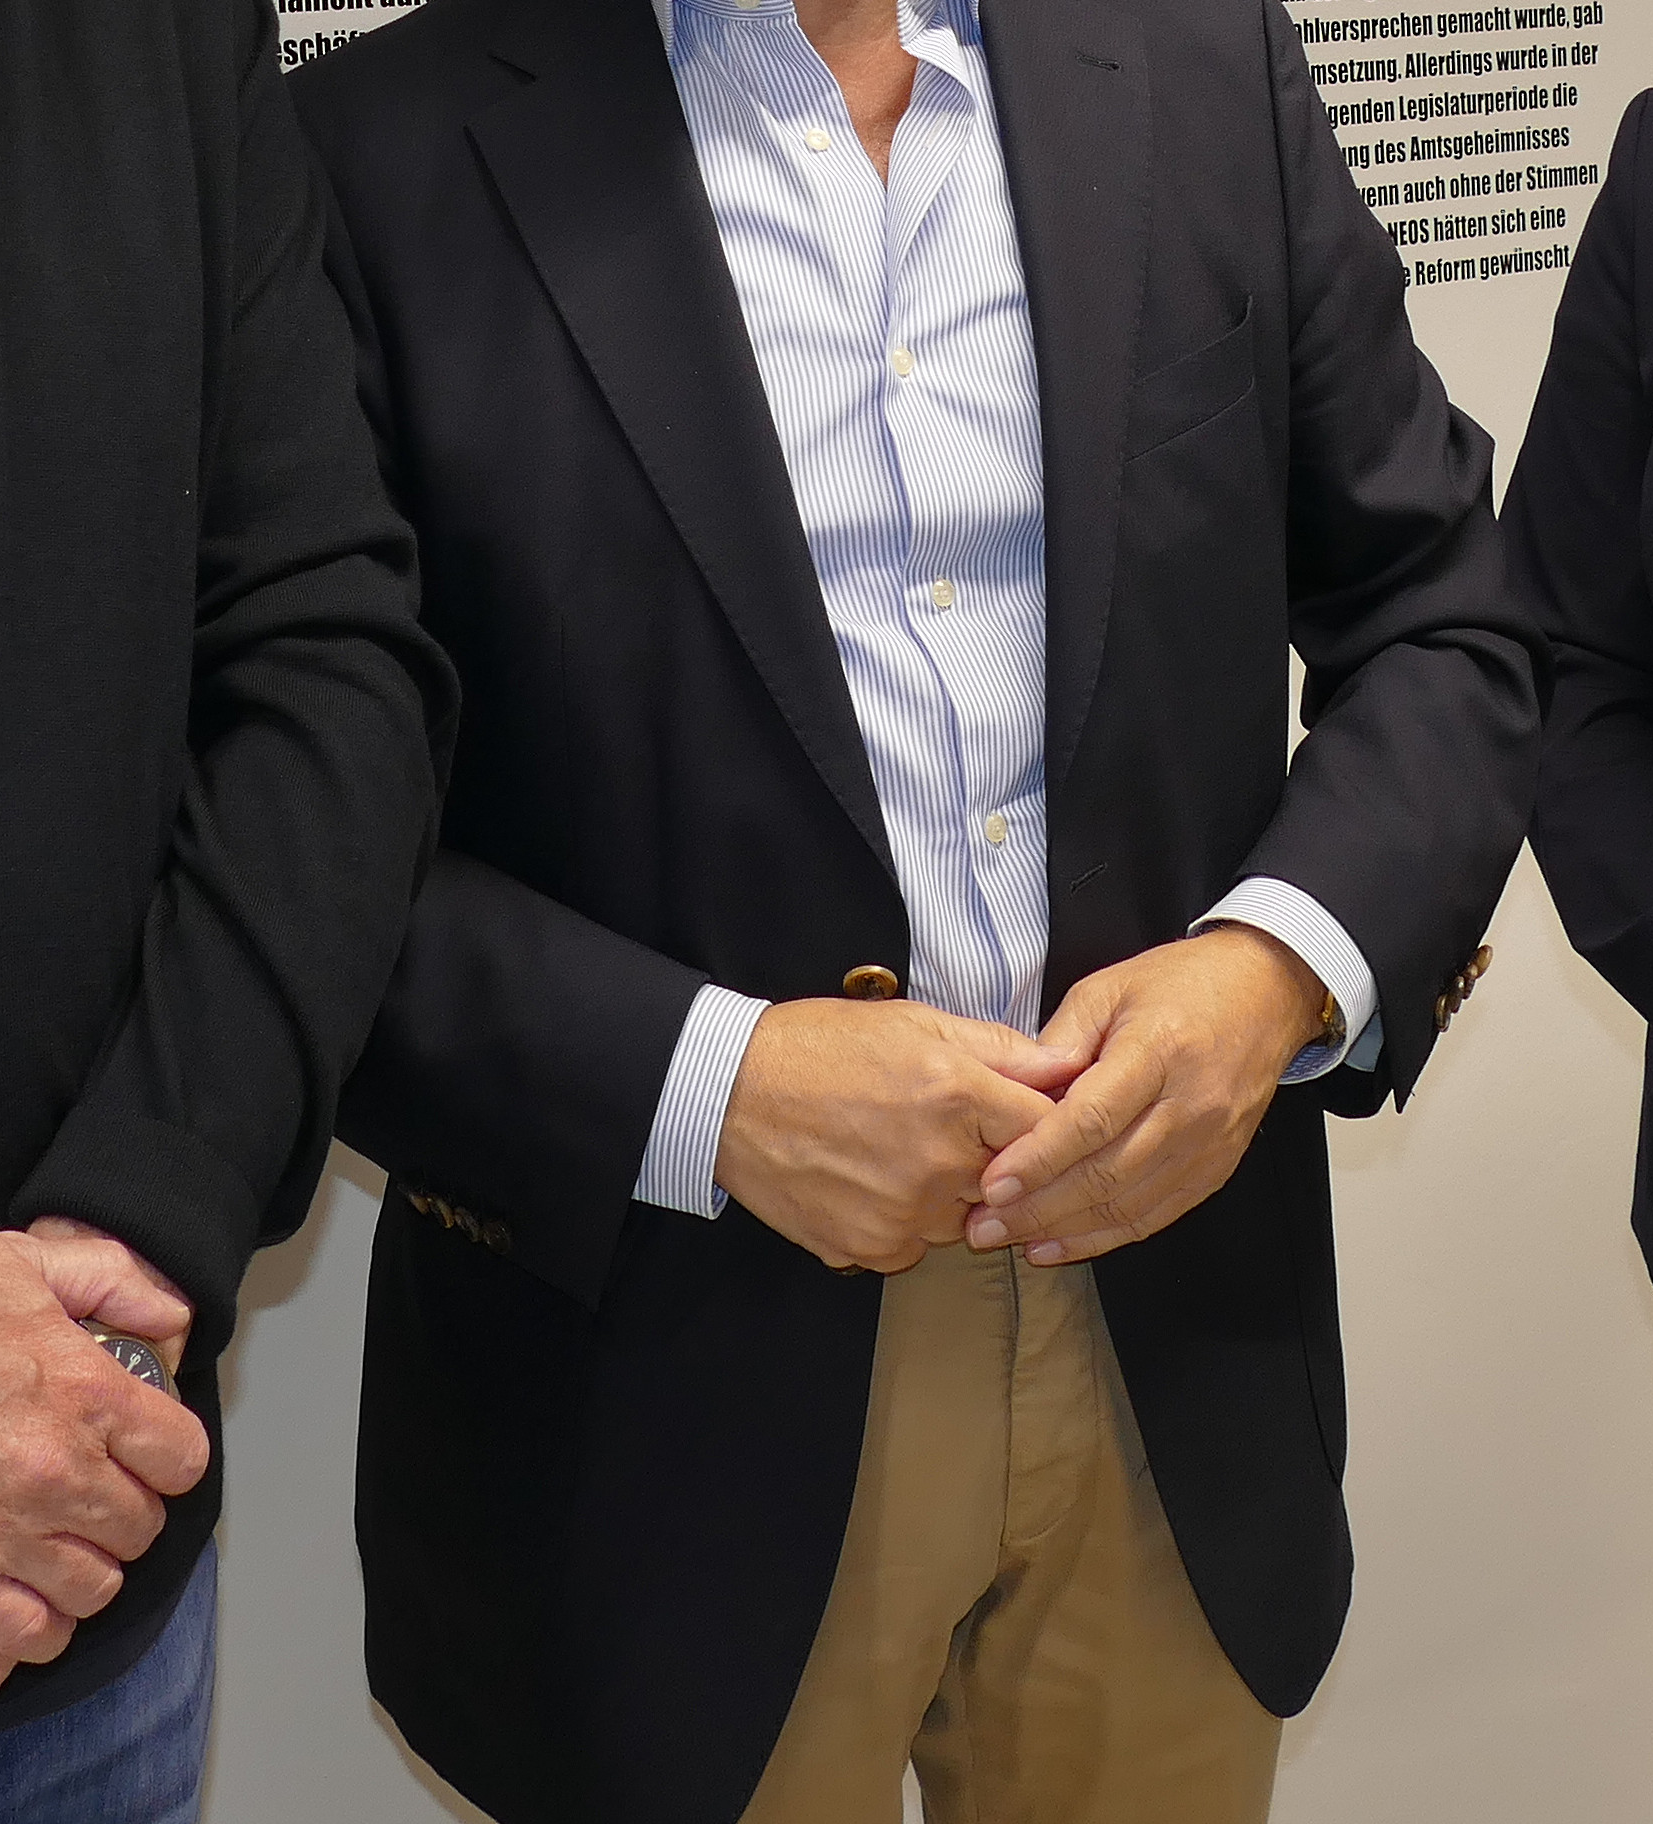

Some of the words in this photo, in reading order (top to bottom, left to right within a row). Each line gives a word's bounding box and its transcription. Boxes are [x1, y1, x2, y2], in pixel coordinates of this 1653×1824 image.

[1437, 7, 1511, 37] gemacht
[1514, 3, 1569, 29] wurde,
[1574, 1, 1602, 28] gab
[1405, 50, 1492, 78] Allerdings
[1496, 45, 1548, 71] wurde
[1552, 44, 1567, 67] in
[1572, 42, 1598, 65] der
[1399, 85, 1548, 121] Legislaturperiode
[1553, 83, 1577, 107] die
[1434, 215, 1487, 241] hätten
[1492, 208, 1526, 234] sich
[1531, 206, 1565, 230] eine
[1415, 259, 1475, 285] Reform
[1480, 244, 1570, 280] gewünscht
